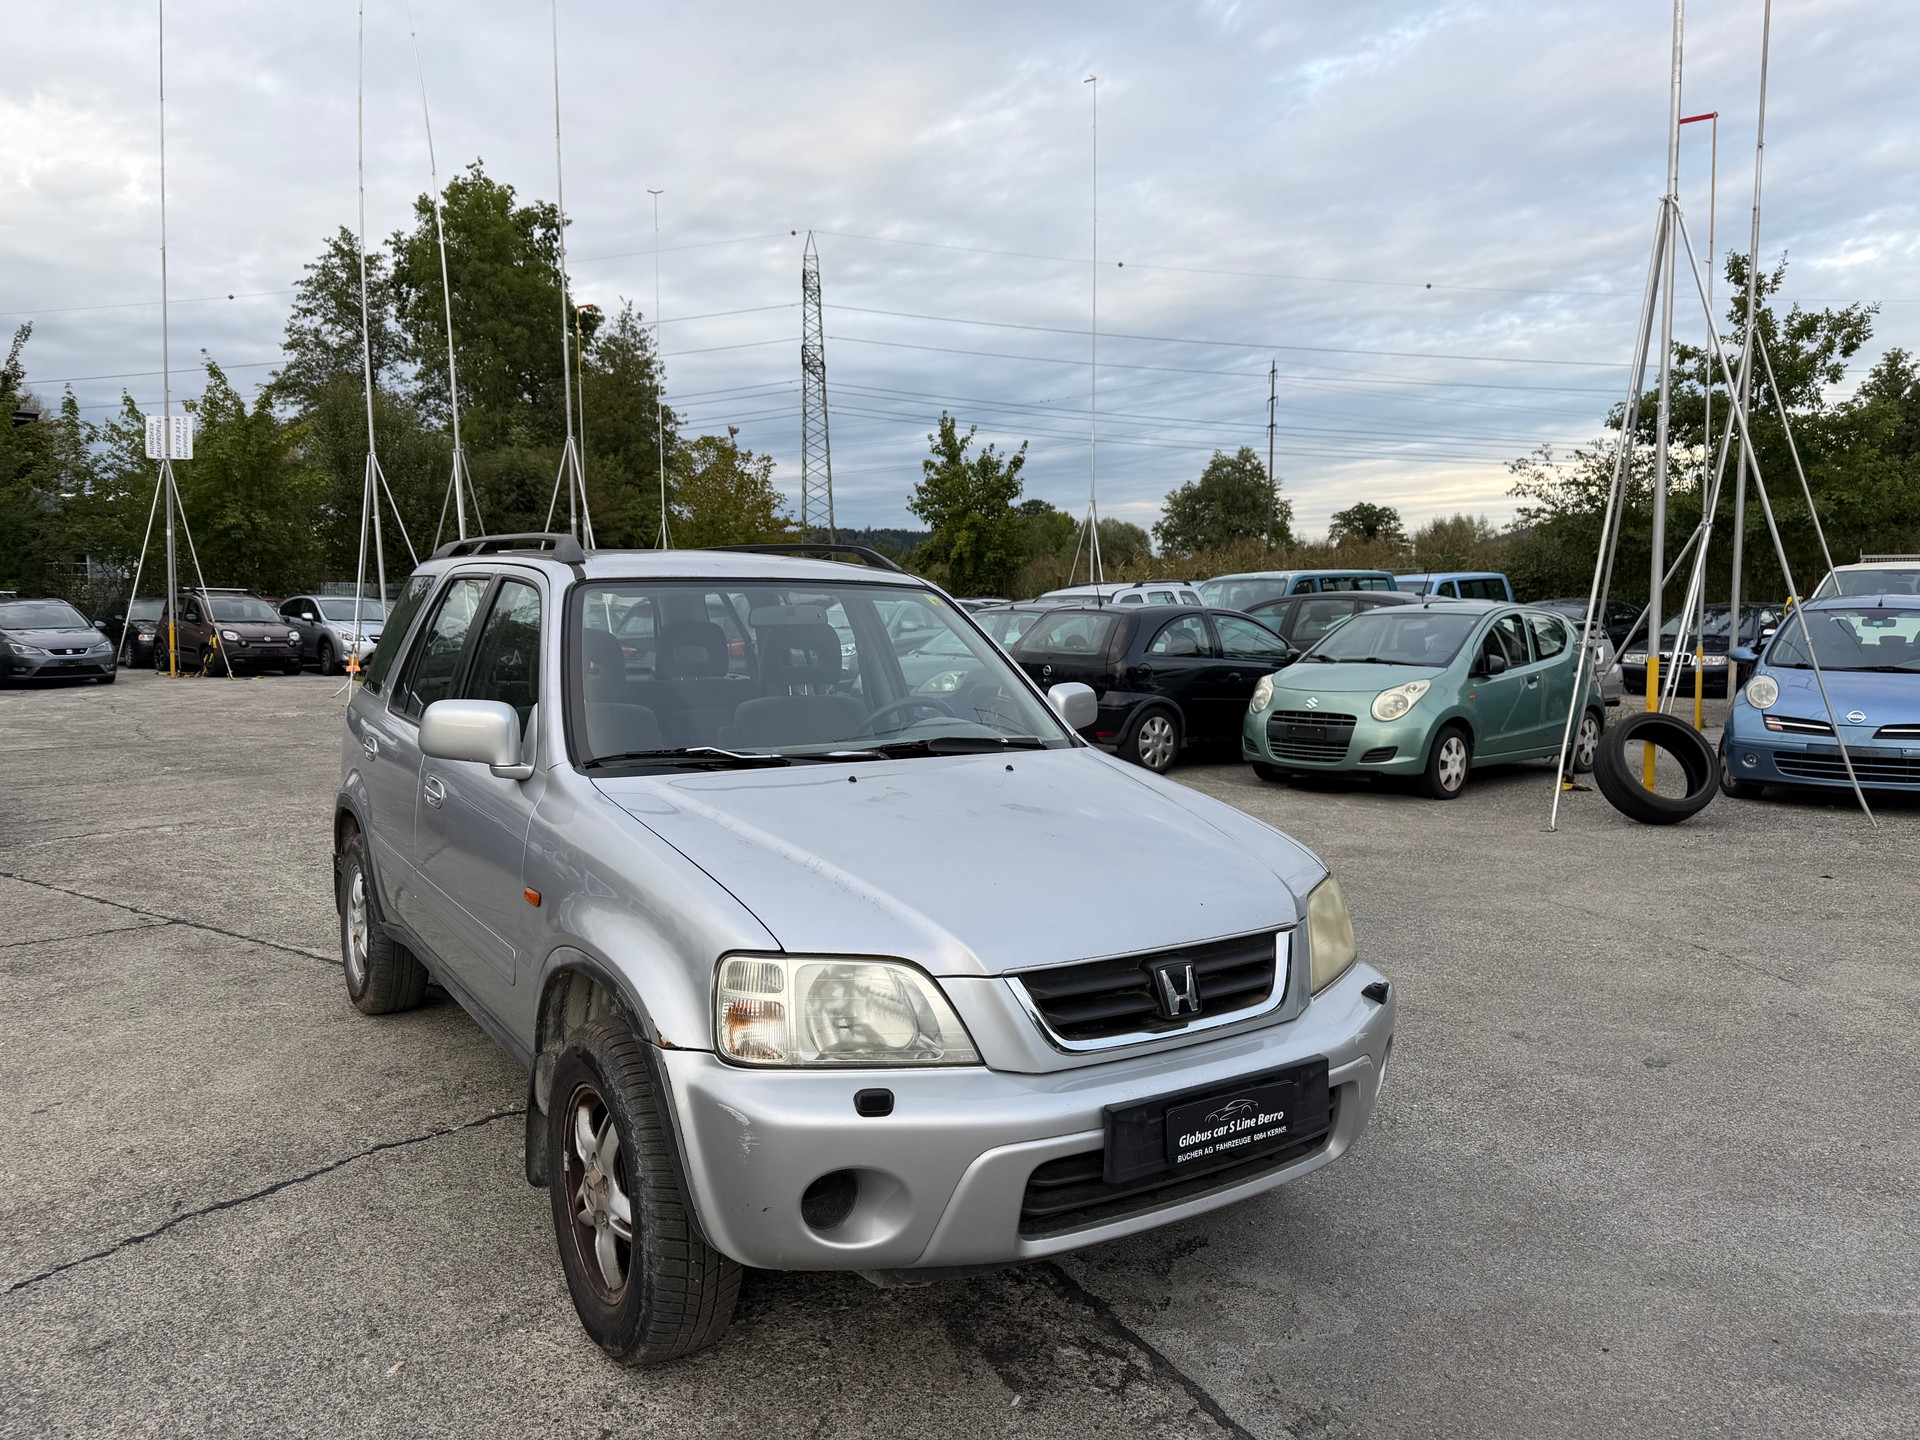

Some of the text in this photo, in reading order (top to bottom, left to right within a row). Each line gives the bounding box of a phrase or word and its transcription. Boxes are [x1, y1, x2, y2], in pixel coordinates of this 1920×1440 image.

[1179, 1110, 1284, 1148] Globus car S Line Berro
[1204, 1146, 1214, 1156] AG
[1216, 1136, 1252, 1152] FAHRZEUGE
[1253, 1132, 1267, 1142] 6064
[1267, 1126, 1287, 1138] KERNS
